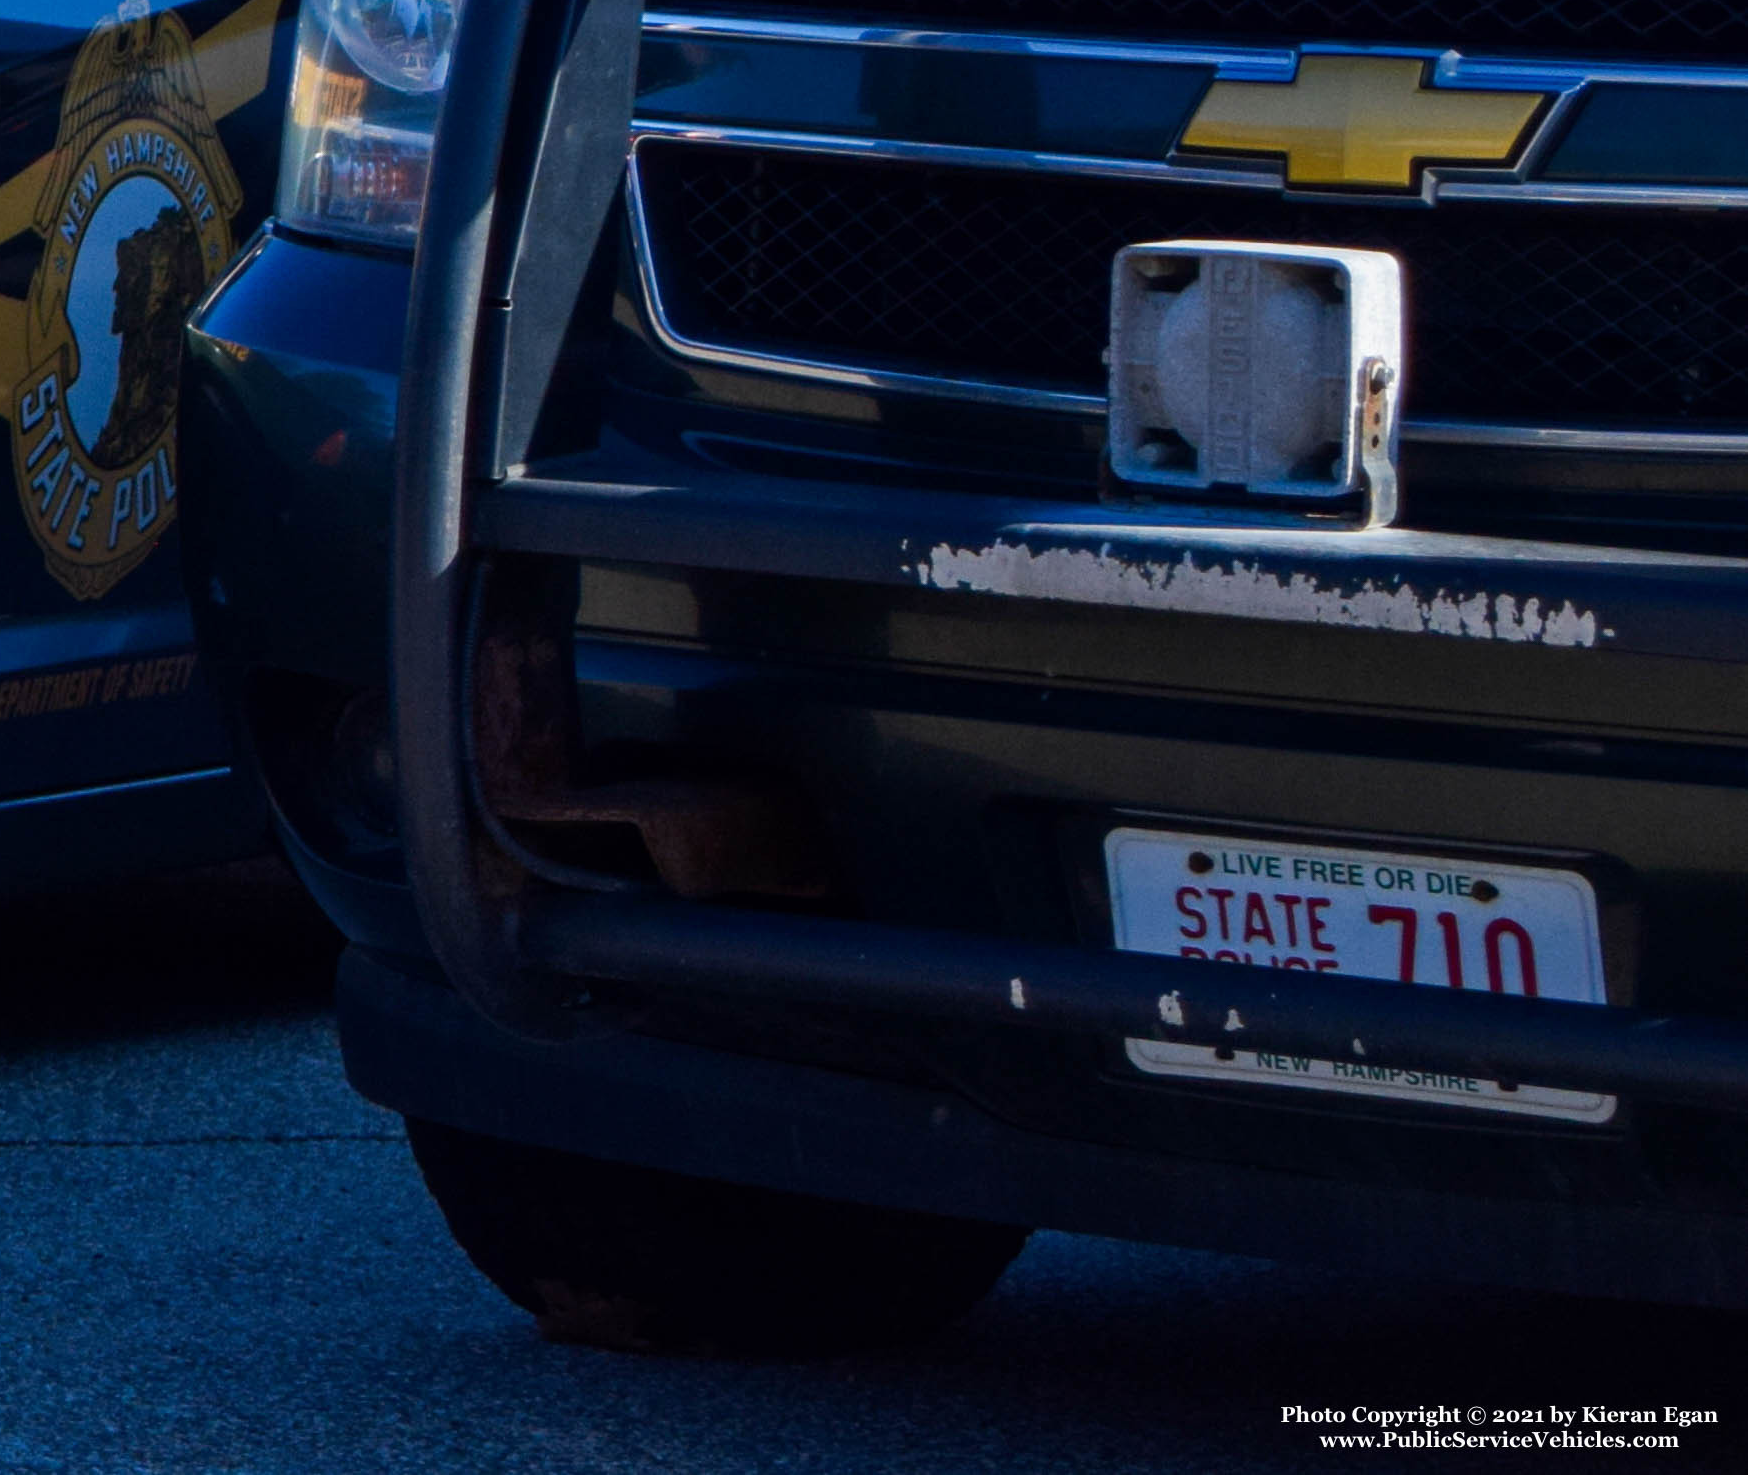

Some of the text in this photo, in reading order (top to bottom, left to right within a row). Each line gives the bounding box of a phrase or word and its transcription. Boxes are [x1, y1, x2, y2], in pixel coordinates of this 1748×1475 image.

[61, 129, 216, 245] NEW HAMPSHIRE
[18, 372, 178, 550] STATE POL
[1221, 852, 1471, 898] LIVE FREE OR DIE
[1174, 886, 1337, 952] STATE
[1256, 1051, 1481, 1093] NEW HAMPSHIRE
